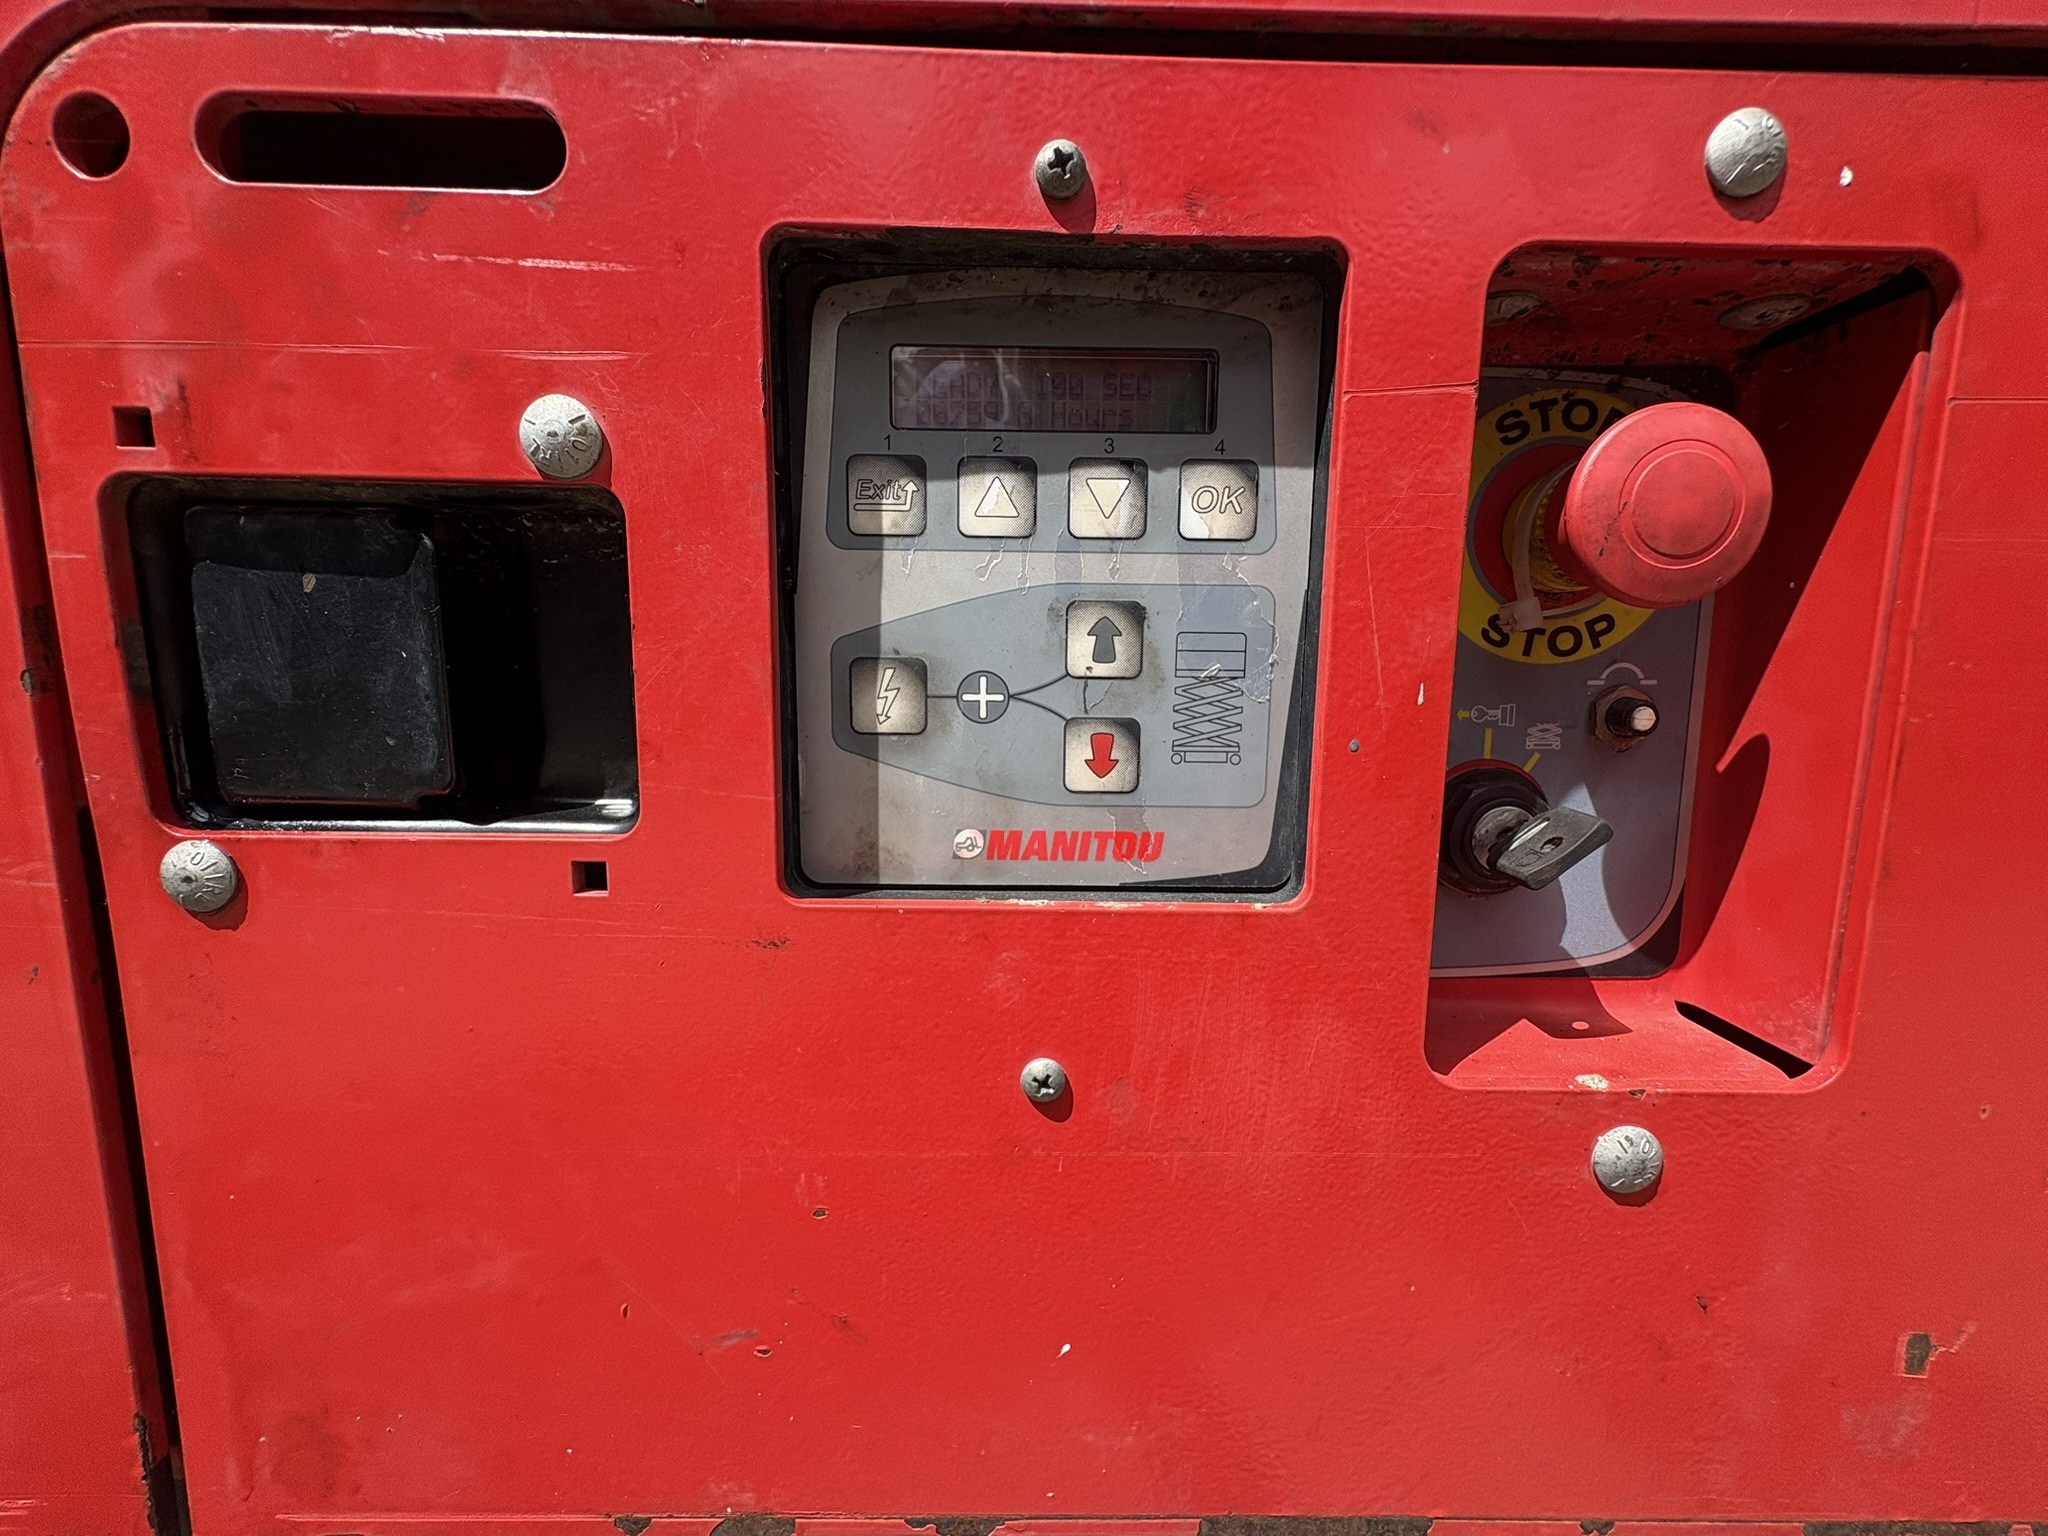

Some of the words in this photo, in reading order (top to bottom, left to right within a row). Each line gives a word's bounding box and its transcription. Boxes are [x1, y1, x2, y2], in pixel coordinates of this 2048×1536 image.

[1103, 372, 1151, 400] SEC
[884, 434, 892, 451] 1
[993, 436, 1004, 452] 2
[1104, 437, 1115, 454] 3
[1215, 439, 1226, 455] 4
[855, 478, 902, 501] Exit
[1191, 485, 1246, 515] OK
[1481, 613, 1616, 658] STOP
[985, 830, 1165, 863] MANITOU
